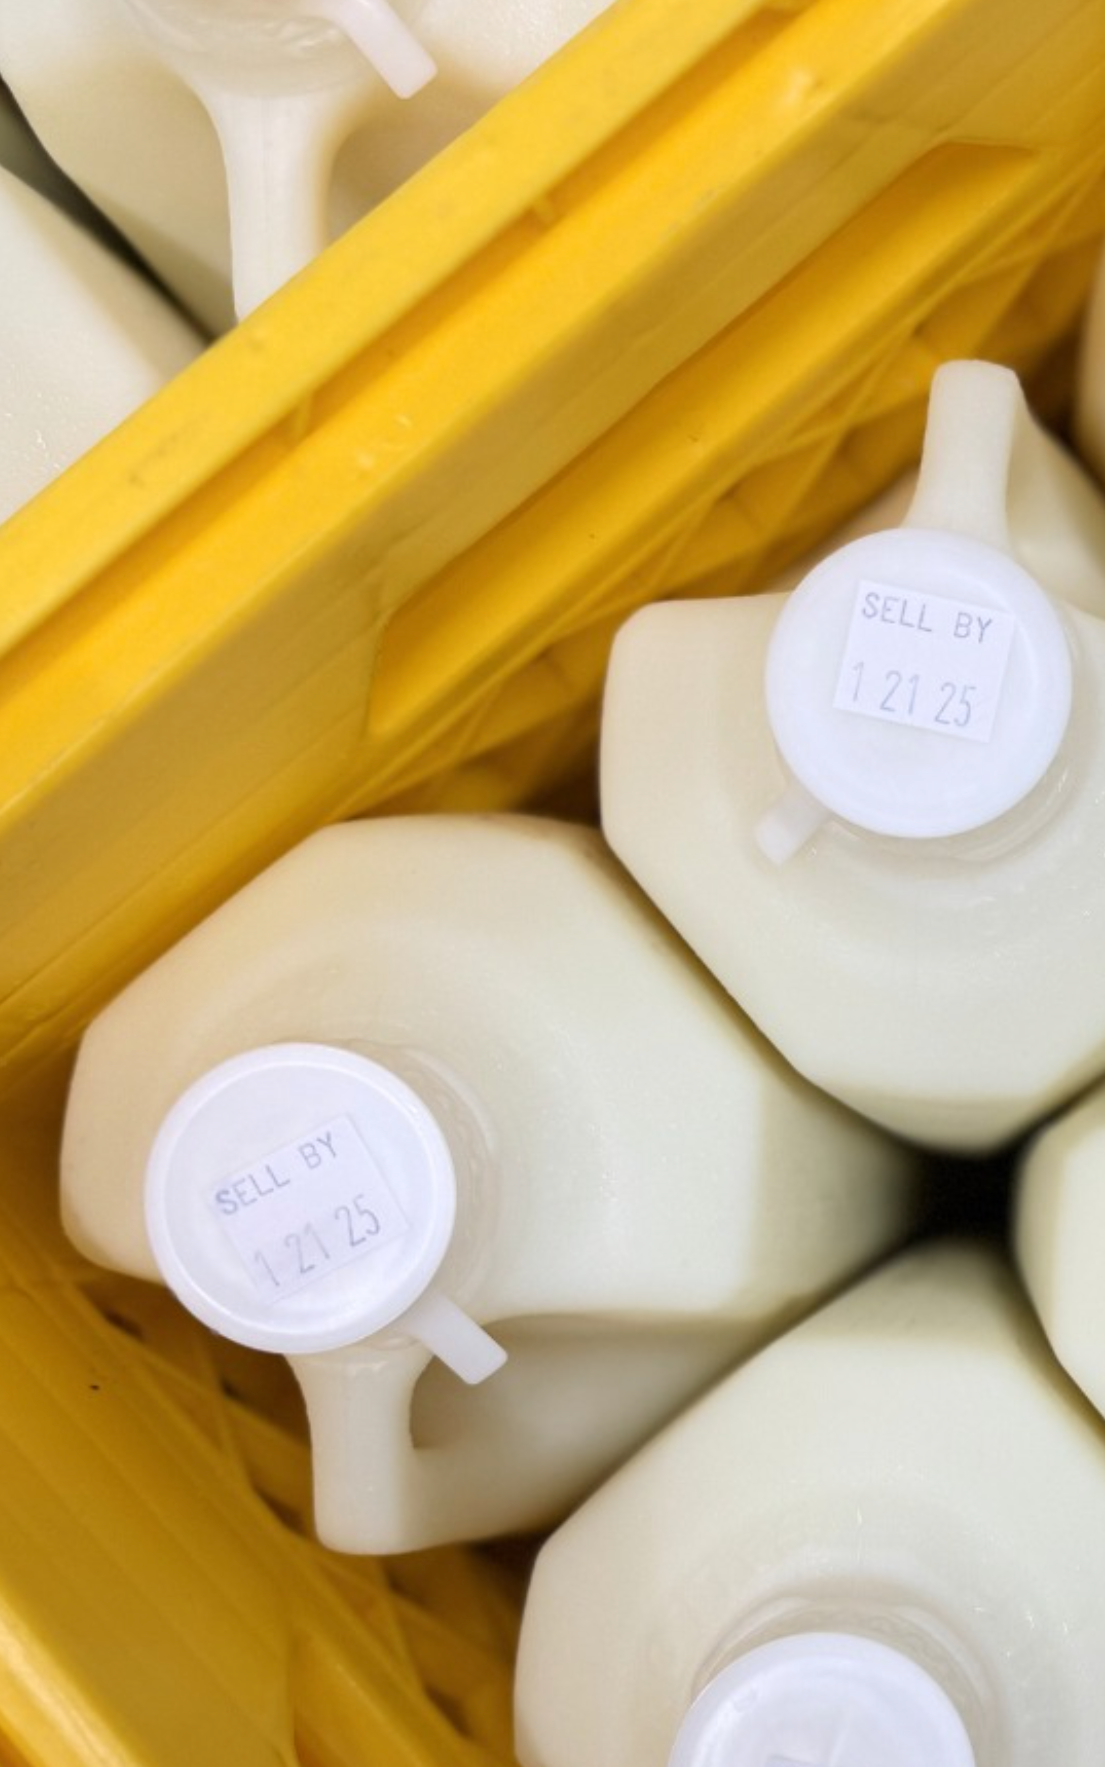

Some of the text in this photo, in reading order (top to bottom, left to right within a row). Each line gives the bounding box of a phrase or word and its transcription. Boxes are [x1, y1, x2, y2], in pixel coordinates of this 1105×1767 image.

[861, 592, 993, 644] SELL BY
[852, 661, 977, 728] 1 21 25
[215, 1131, 337, 1215] SELL BY
[254, 1193, 380, 1287] 1 21 25
